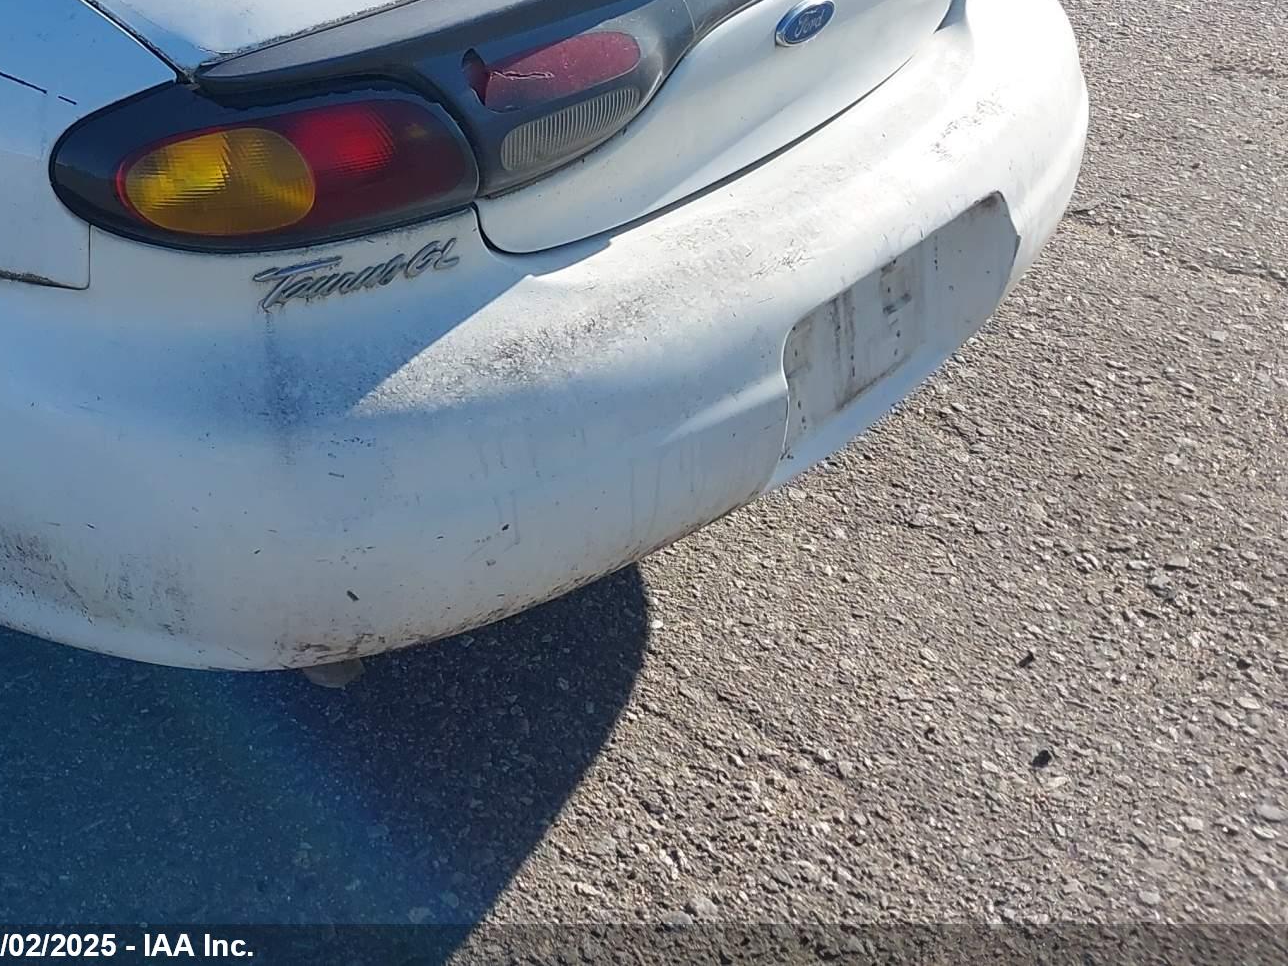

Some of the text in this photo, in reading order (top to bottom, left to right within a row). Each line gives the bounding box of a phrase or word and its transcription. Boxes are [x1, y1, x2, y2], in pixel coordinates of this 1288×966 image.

[794, 8, 826, 39] Ford
[252, 237, 460, 312] Taurus GL
